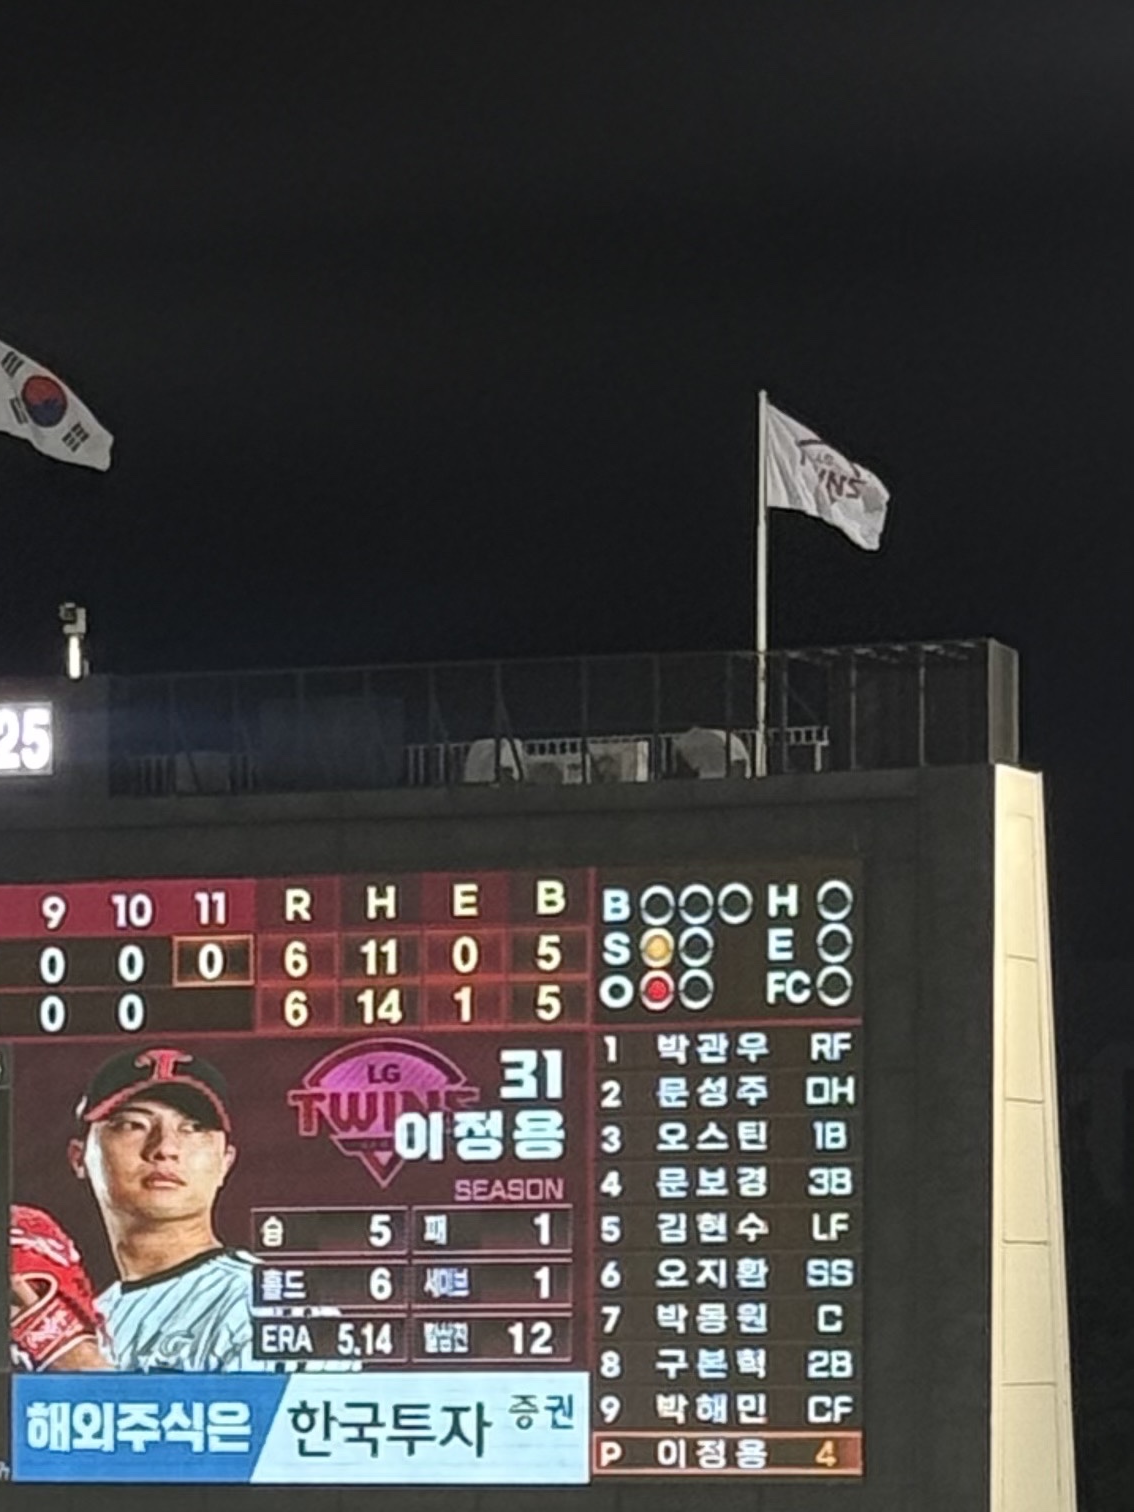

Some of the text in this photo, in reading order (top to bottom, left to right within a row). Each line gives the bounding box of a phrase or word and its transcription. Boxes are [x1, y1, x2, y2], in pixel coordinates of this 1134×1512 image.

[42, 896, 65, 928] 9
[112, 894, 152, 927] 10
[195, 892, 226, 924] 11
[286, 889, 310, 920] R
[367, 886, 396, 918] H
[454, 884, 478, 915] E
[537, 881, 564, 914] B
[604, 890, 630, 921] B
[769, 884, 797, 916] H
[199, 944, 223, 979] 0
[285, 941, 308, 975] 6
[361, 940, 397, 974] 11
[453, 937, 477, 972] 0
[537, 935, 560, 971] 5
[604, 933, 630, 965] S
[769, 929, 793, 959] E
[768, 971, 811, 1003] FC
[285, 991, 308, 1026] 6
[358, 990, 401, 1024] 14
[455, 987, 471, 1022] 1
[537, 986, 560, 1021] 5
[604, 1032, 852, 1064] 1 박관우 RF
[368, 1064, 400, 1082] LG
[500, 1050, 562, 1098] 31
[601, 1080, 621, 1108] 2
[656, 1076, 768, 1107] 문성주
[395, 1110, 564, 1161] 이정용
[601, 1121, 847, 1153] 3 오스틴 1B
[455, 1178, 563, 1200] SEASON
[600, 1166, 852, 1198] 4 문보경 3B
[370, 1215, 391, 1246] 5
[534, 1213, 550, 1245] 1
[601, 1212, 849, 1243] 5 김현수 LF
[370, 1268, 391, 1300] 6
[534, 1267, 550, 1299] 1
[600, 1258, 854, 1289] 6 오지환 SS
[601, 1303, 843, 1334] 7 박동원 C
[262, 1325, 312, 1352] ERA
[338, 1323, 392, 1355] 5.14
[508, 1322, 552, 1355] 12
[600, 1348, 853, 1379] 8 구본혁 2B
[600, 1393, 853, 1424] 9 박해민 CF
[26, 1394, 573, 1458] 해외주식은 한국투자 증권
[601, 1438, 837, 1469] P 이정용 4
